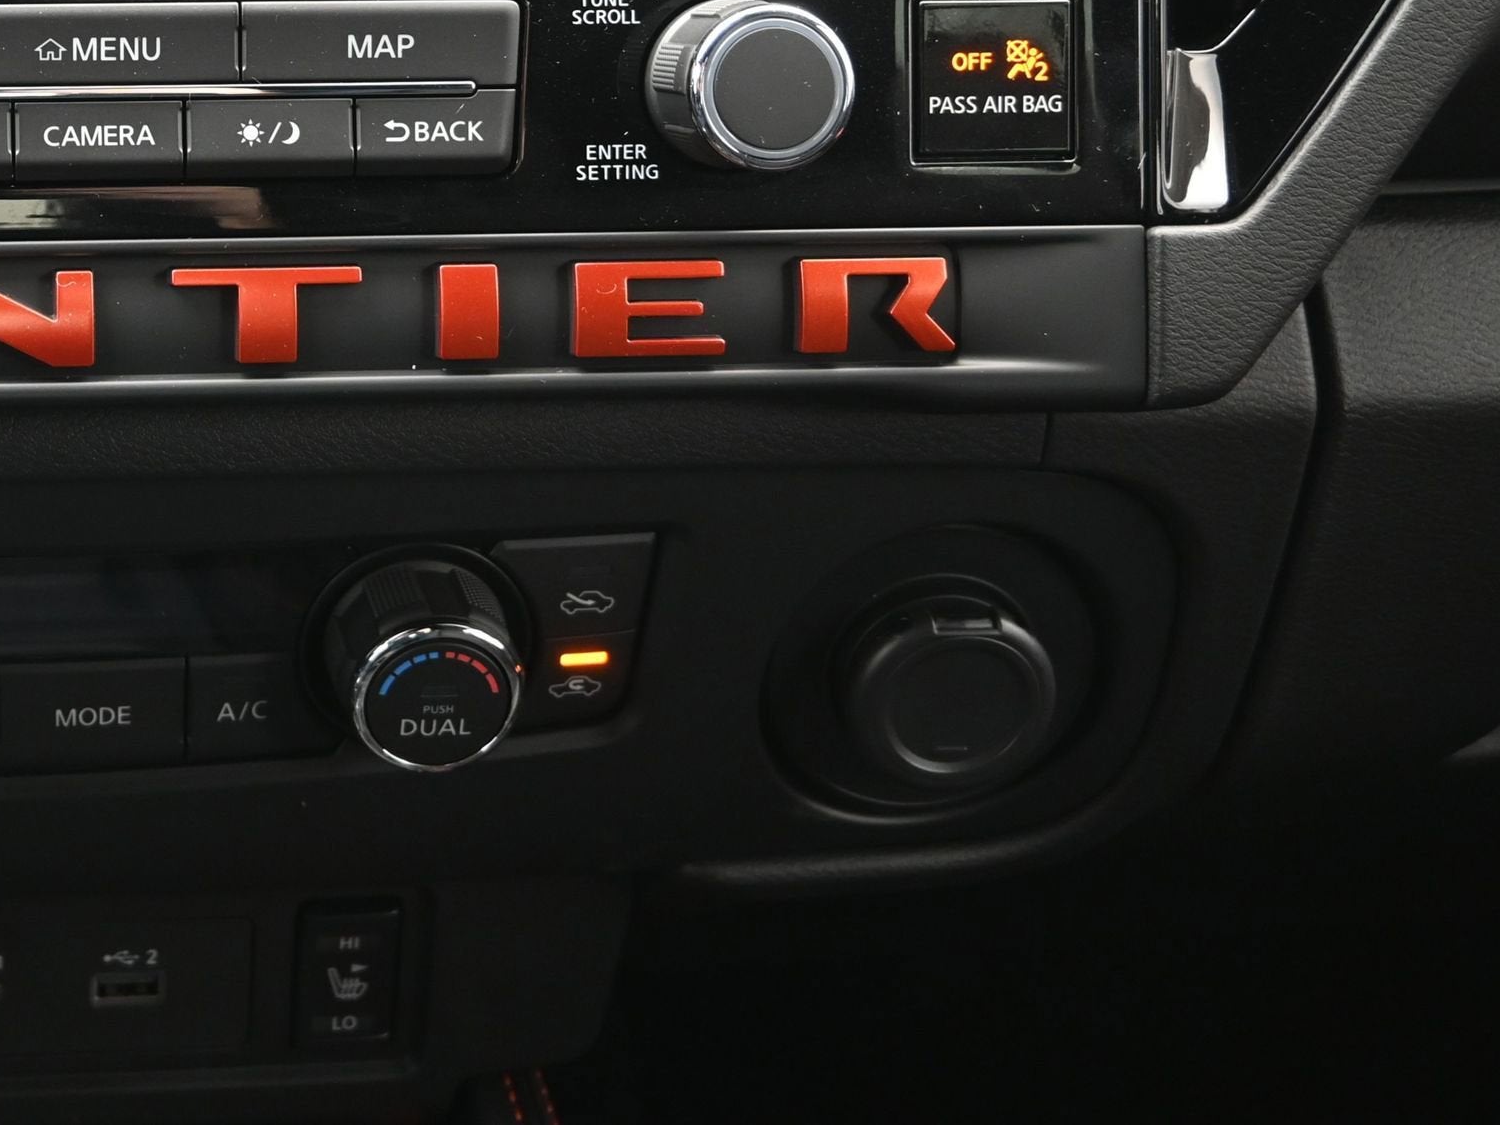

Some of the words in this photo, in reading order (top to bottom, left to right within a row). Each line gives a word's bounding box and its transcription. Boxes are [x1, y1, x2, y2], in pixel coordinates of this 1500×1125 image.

[571, 9, 641, 26] SCROLL
[71, 37, 162, 63] MENU
[346, 34, 415, 60] MAP
[951, 52, 992, 72] OFF
[928, 96, 977, 115] PASS
[982, 96, 1018, 114] AIR
[1023, 95, 1063, 114] BAG
[42, 124, 156, 148] CAMERA
[413, 119, 484, 143] BACK
[585, 144, 647, 160] ENTER
[575, 163, 660, 181] SETTING
[54, 705, 132, 728] MODE
[217, 699, 268, 723] A/C
[422, 704, 454, 715] PUSH
[400, 718, 471, 736] DUAL
[340, 936, 360, 950] HI
[332, 1016, 357, 1031] LO
